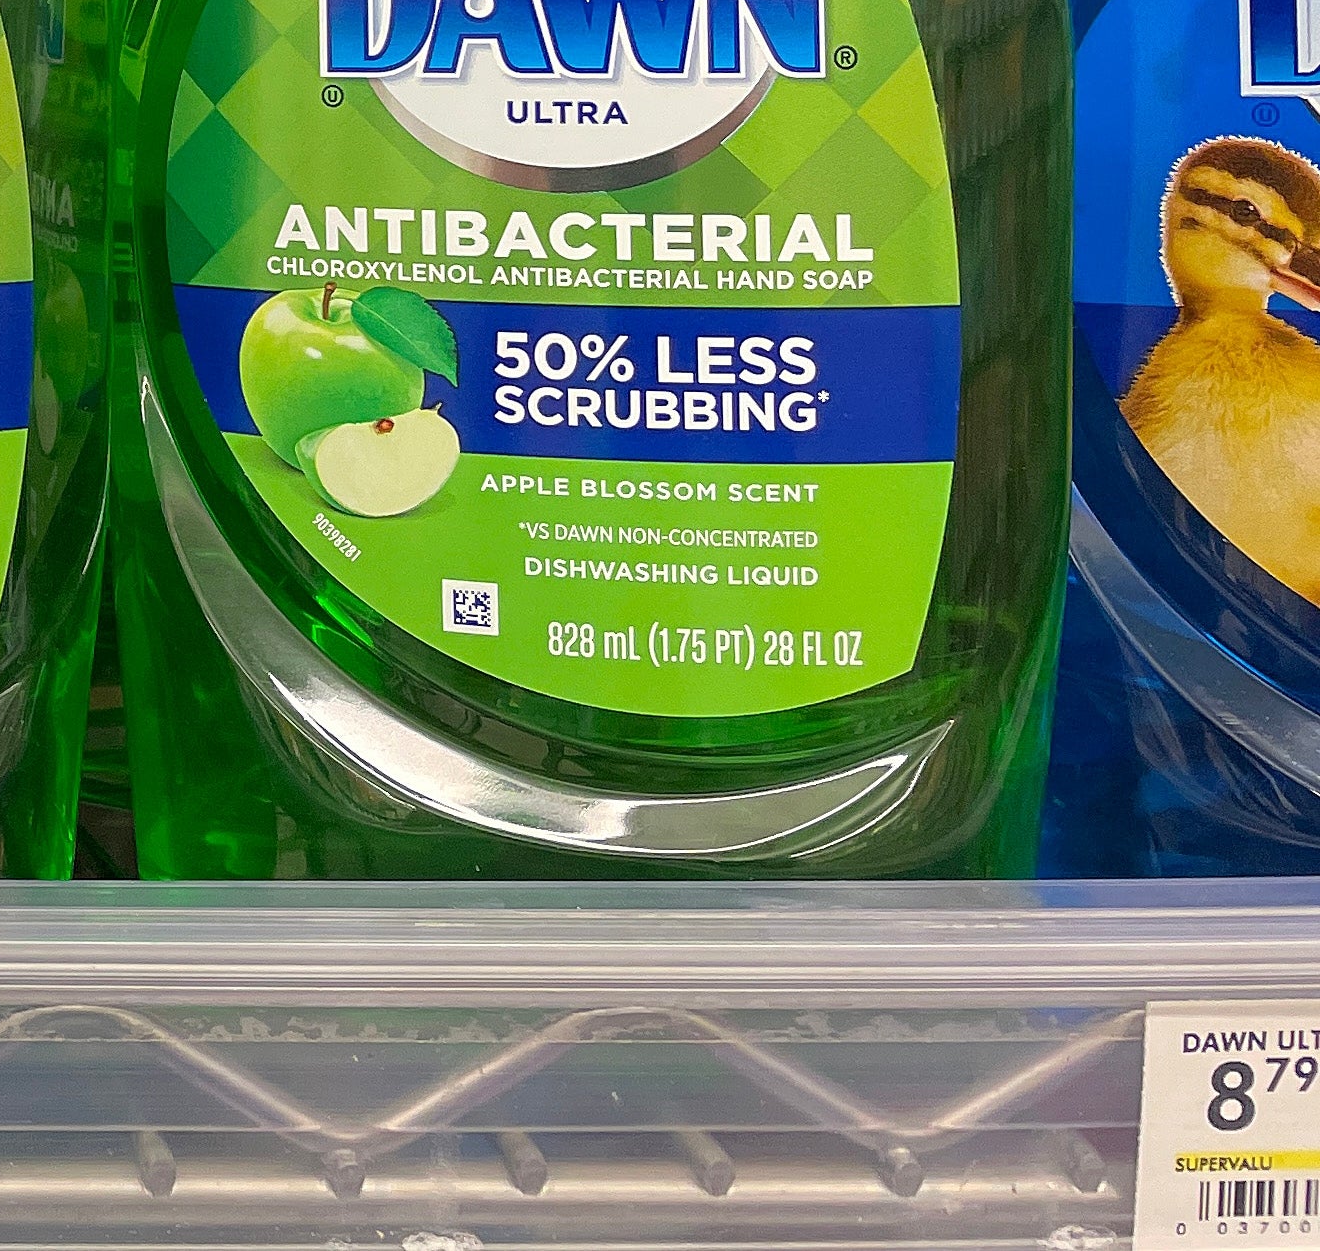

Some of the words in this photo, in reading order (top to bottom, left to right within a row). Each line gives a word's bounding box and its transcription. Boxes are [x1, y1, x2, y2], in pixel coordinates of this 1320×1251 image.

[507, 101, 628, 124] ULTRA
[275, 205, 873, 261] ANTIBACTERIAL
[267, 256, 482, 284] CHLOROXYLENOL
[491, 266, 708, 289] ANTIBACTERIAL
[718, 270, 794, 289] HAND
[803, 270, 872, 289] SOAP
[495, 332, 634, 382] 50%
[658, 337, 816, 384] LESS
[481, 474, 569, 495] APPLE
[582, 479, 716, 500] BLOSSOM
[729, 484, 818, 502] SCENT
[312, 511, 362, 561] 90398281
[555, 524, 612, 543] DAWN
[619, 527, 818, 547] NON-CONCENTRATED
[525, 557, 718, 584] DISHWASHING
[728, 566, 818, 585] LIQUID
[549, 622, 594, 657] 828
[604, 626, 640, 660] mL
[649, 622, 706, 667] (1.75
[716, 625, 755, 670] PT)
[764, 631, 794, 665] 28
[803, 631, 827, 665] FL
[834, 631, 863, 665] OZ
[1183, 1031, 1267, 1053] DAWN
[1208, 1061, 1255, 1131] 8
[1266, 1057, 1318, 1092] 79
[1175, 1157, 1272, 1172] SUPERVALU
